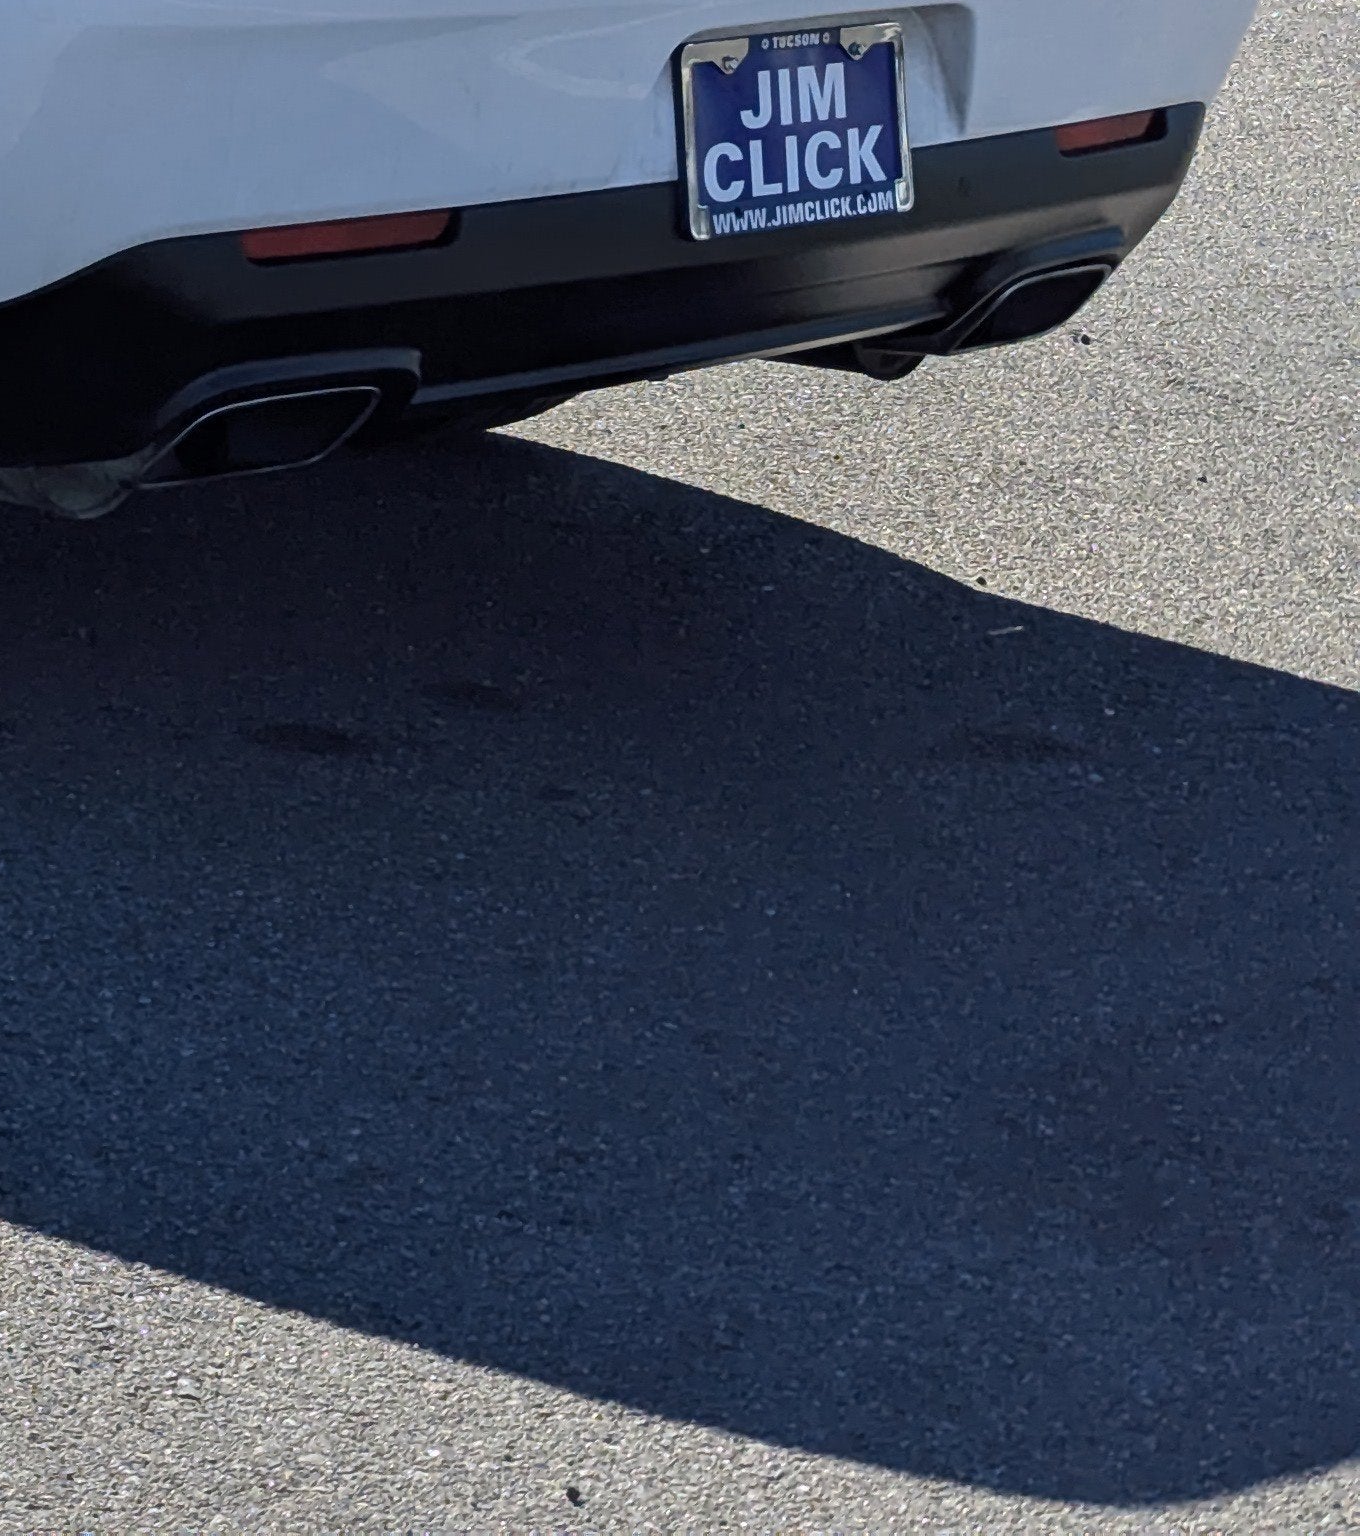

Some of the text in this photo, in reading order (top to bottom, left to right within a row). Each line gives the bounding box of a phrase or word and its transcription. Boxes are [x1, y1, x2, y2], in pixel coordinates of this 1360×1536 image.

[771, 32, 820, 49] TUCSON
[740, 62, 847, 130] JIM
[704, 124, 887, 203] CLICK
[712, 190, 894, 235] WWW.JIMCLICK.COM
